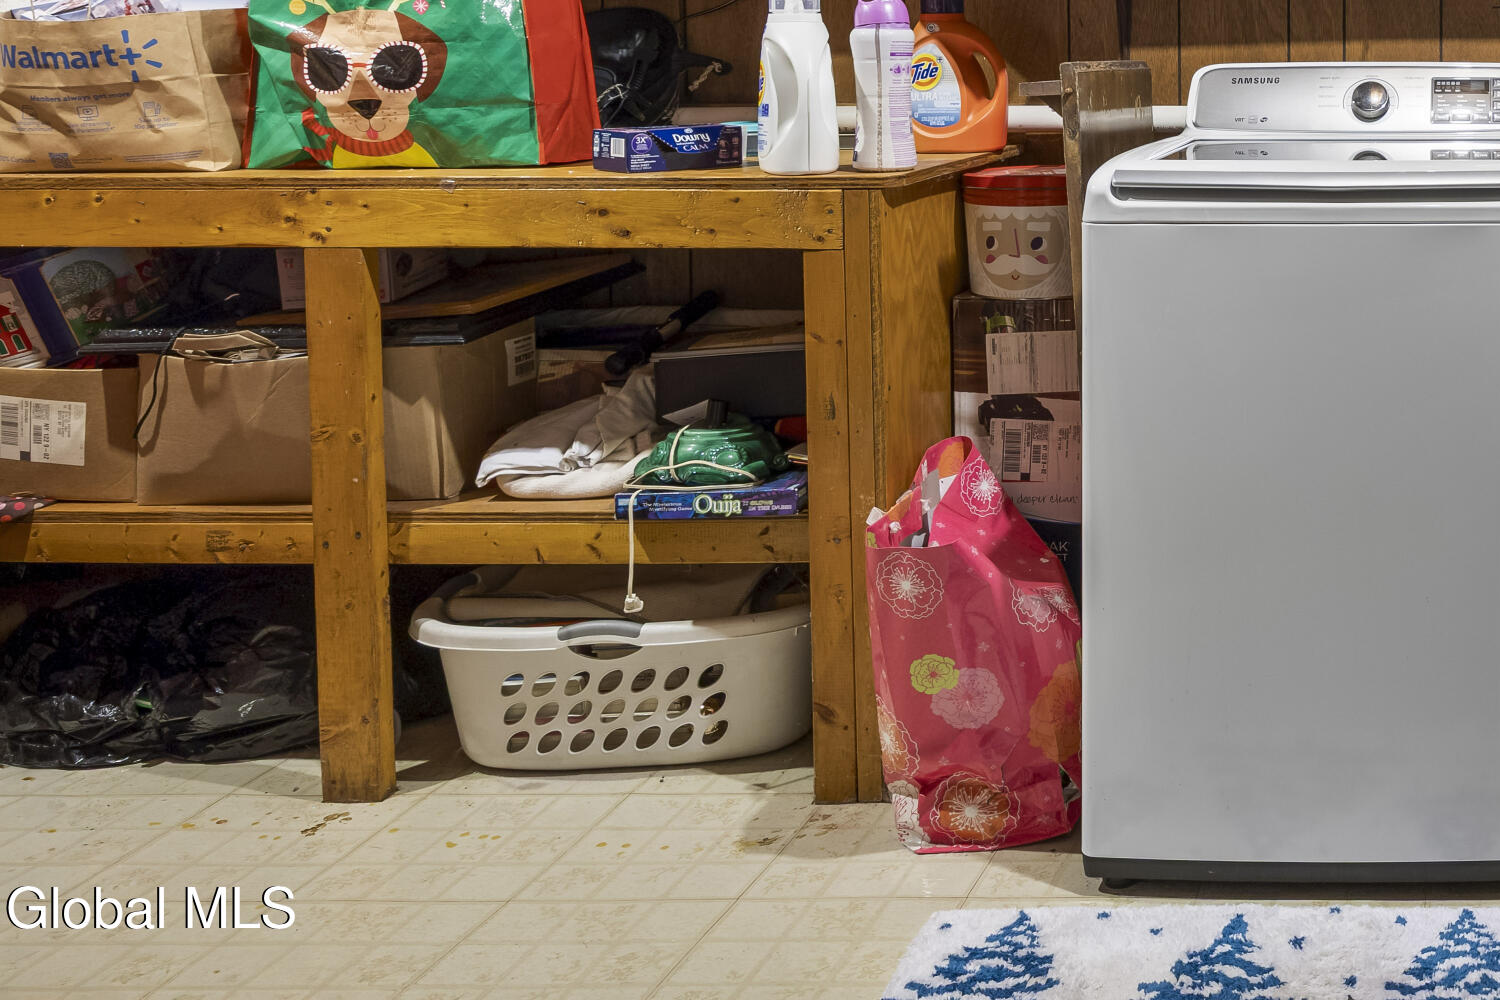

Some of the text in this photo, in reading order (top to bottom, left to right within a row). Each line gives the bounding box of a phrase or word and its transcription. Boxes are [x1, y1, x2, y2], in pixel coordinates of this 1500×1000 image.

[912, 62, 939, 84] Tide
[1231, 77, 1280, 85] SAMSUNG
[672, 132, 711, 143] Downy
[683, 143, 709, 152] CALM
[693, 494, 743, 517] Ouija
